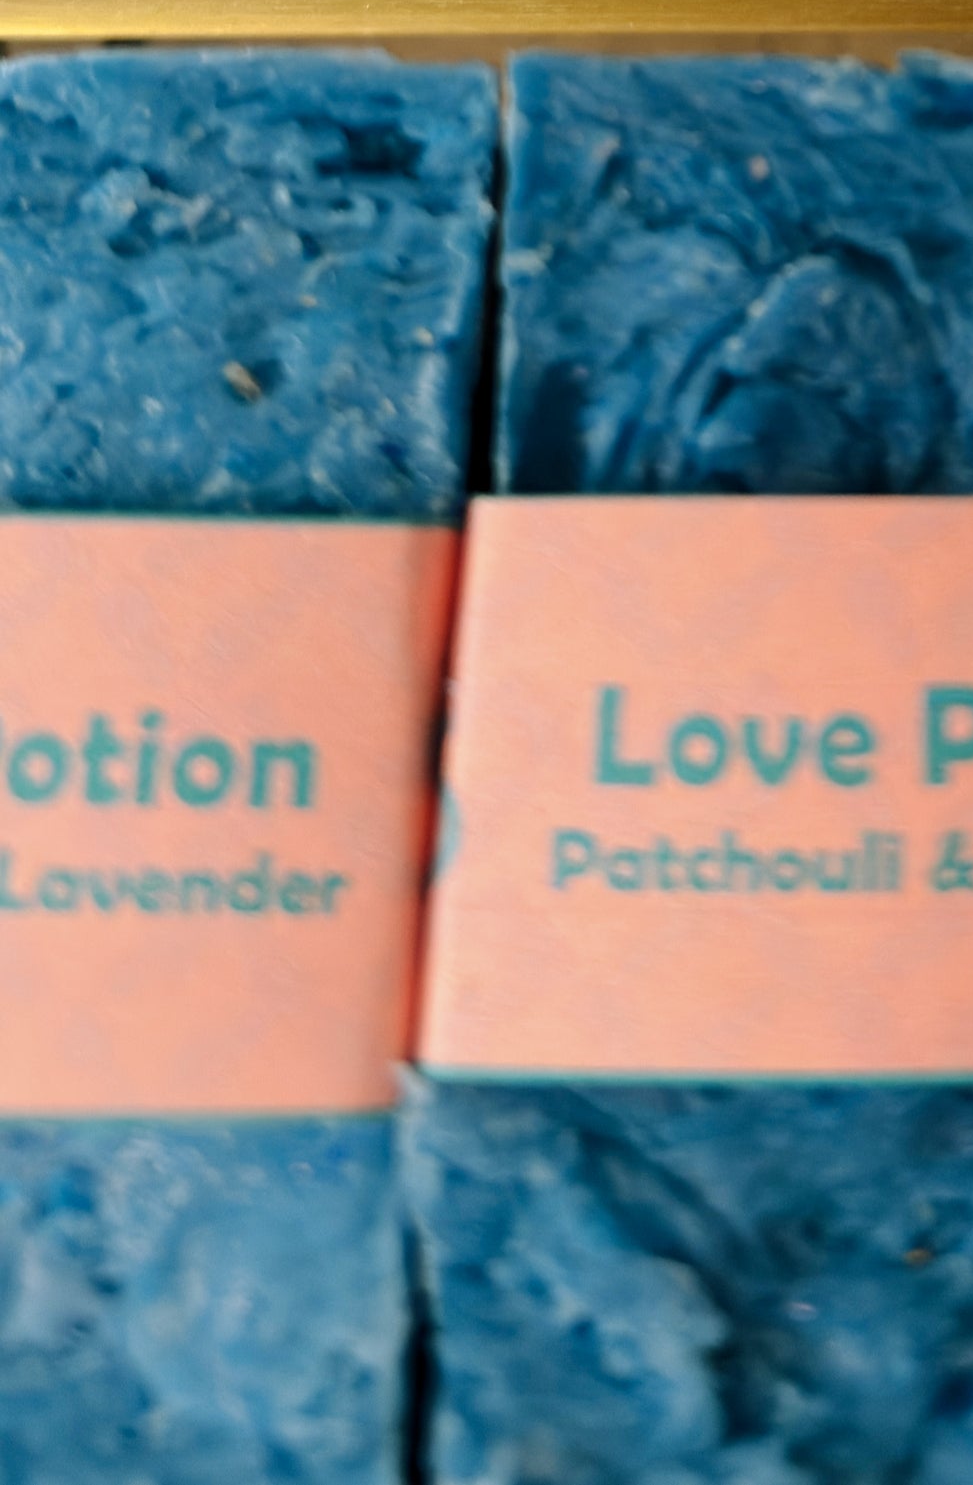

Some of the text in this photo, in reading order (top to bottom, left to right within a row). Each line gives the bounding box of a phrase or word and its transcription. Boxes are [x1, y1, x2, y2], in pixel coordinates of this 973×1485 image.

[0, 709, 316, 808] otion
[594, 684, 877, 788] Love
[0, 849, 350, 916] Lavender
[551, 829, 904, 893] Patchouli
